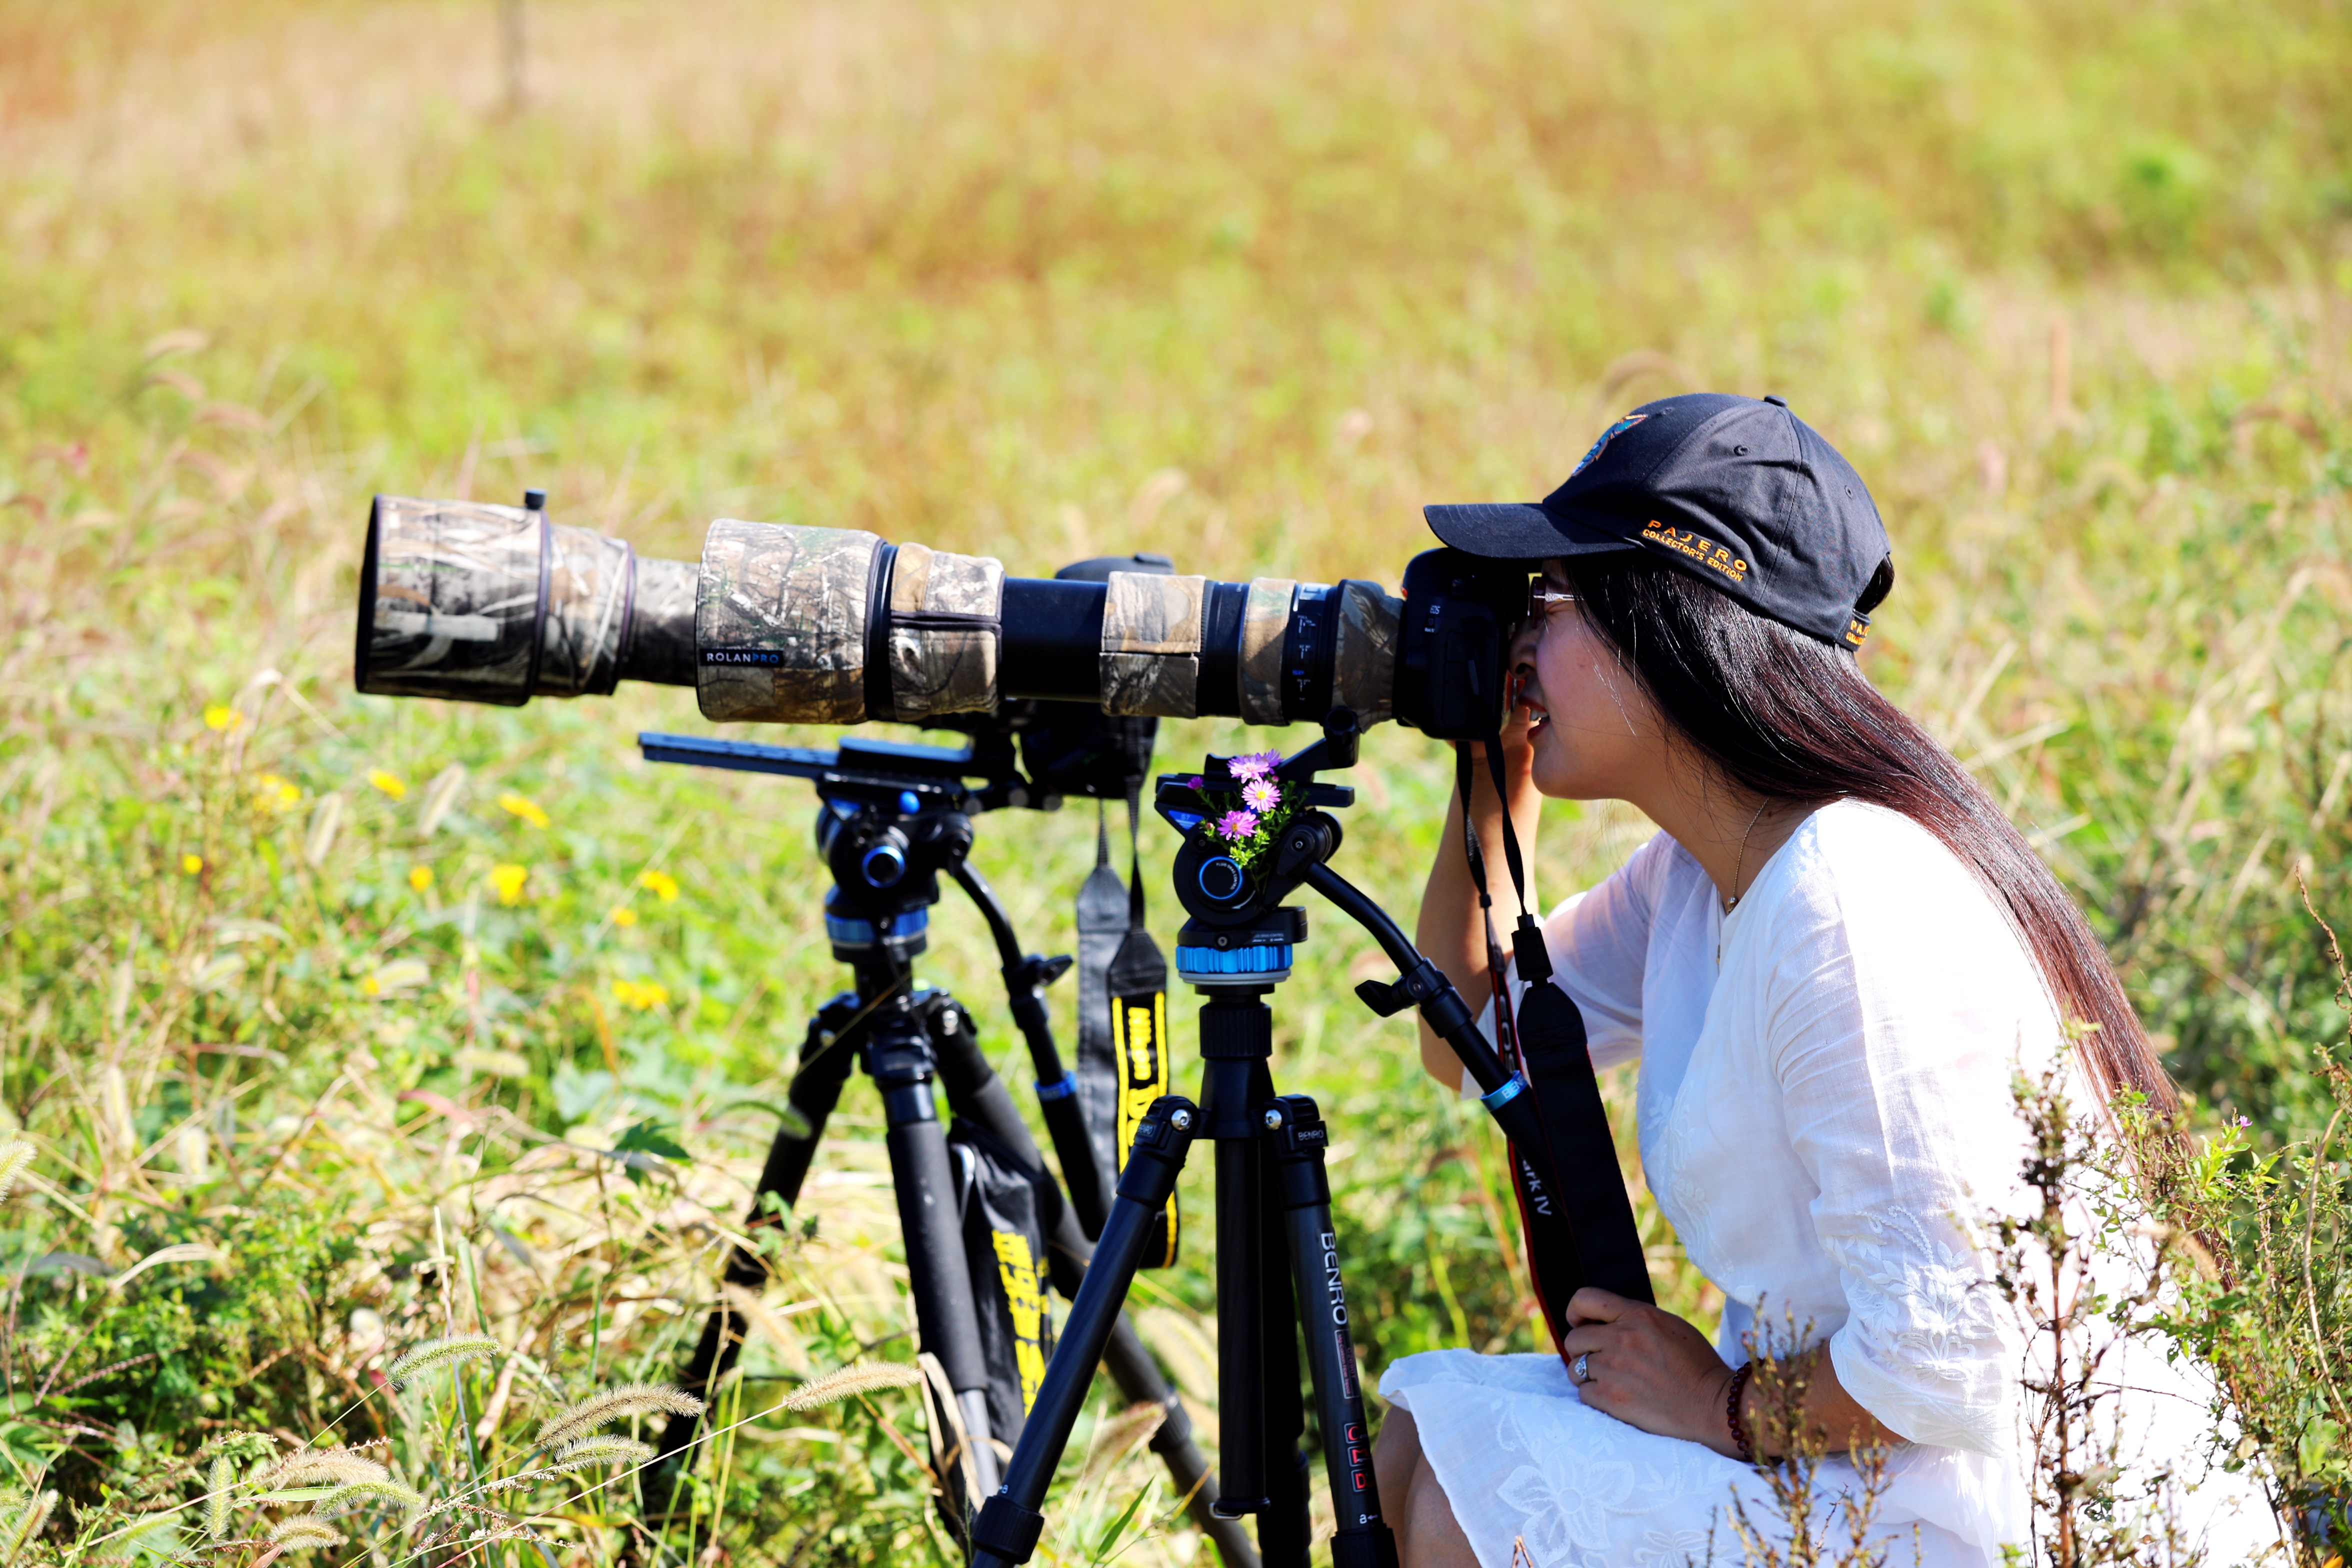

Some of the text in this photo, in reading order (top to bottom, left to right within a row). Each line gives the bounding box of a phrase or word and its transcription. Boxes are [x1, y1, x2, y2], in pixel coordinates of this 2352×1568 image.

[1642, 528, 1744, 582] COLLECTOR'S EDITION
[1648, 520, 1747, 572] PAJERO
[1430, 604, 1441, 615] EOS
[706, 652, 779, 664] ROLANPRO
[1128, 1007, 1152, 1080] Nikon
[1298, 1129, 1324, 1142] BENRO
[1522, 1160, 1552, 1216] ark IV
[1320, 1232, 1348, 1325] BENRO
